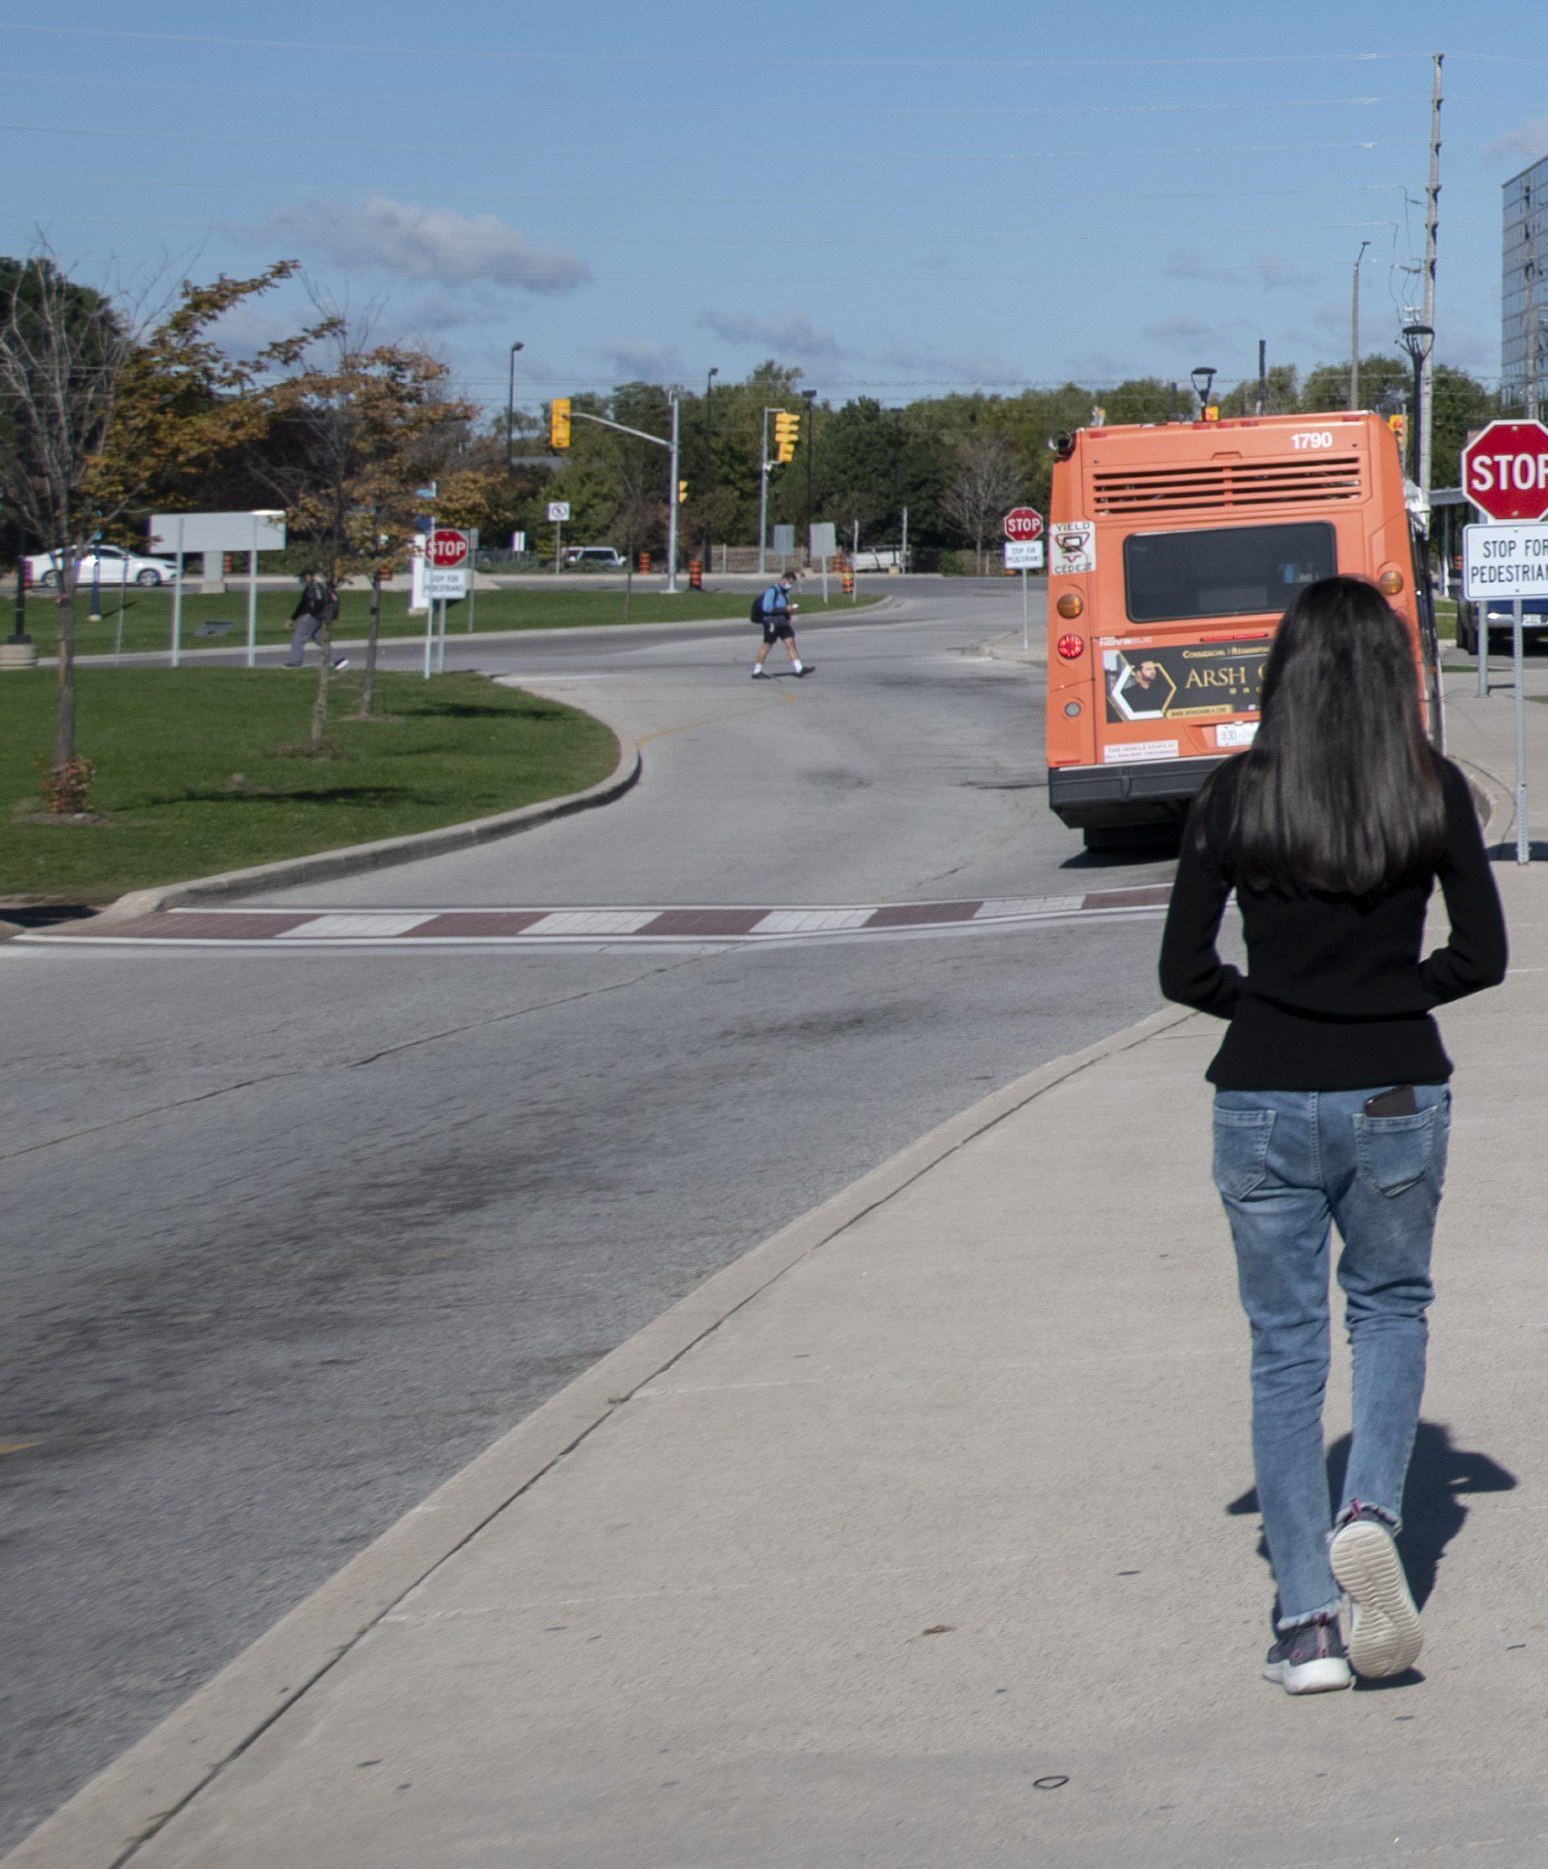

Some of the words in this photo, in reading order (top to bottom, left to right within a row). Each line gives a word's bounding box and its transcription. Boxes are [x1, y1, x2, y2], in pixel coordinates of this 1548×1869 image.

[1291, 431, 1333, 450] 1790
[1008, 518, 1040, 532] STOP
[1055, 522, 1090, 532] YIELD
[428, 540, 466, 556] STOP
[1483, 540, 1517, 559] STOP
[1185, 666, 1246, 689] ARSH
